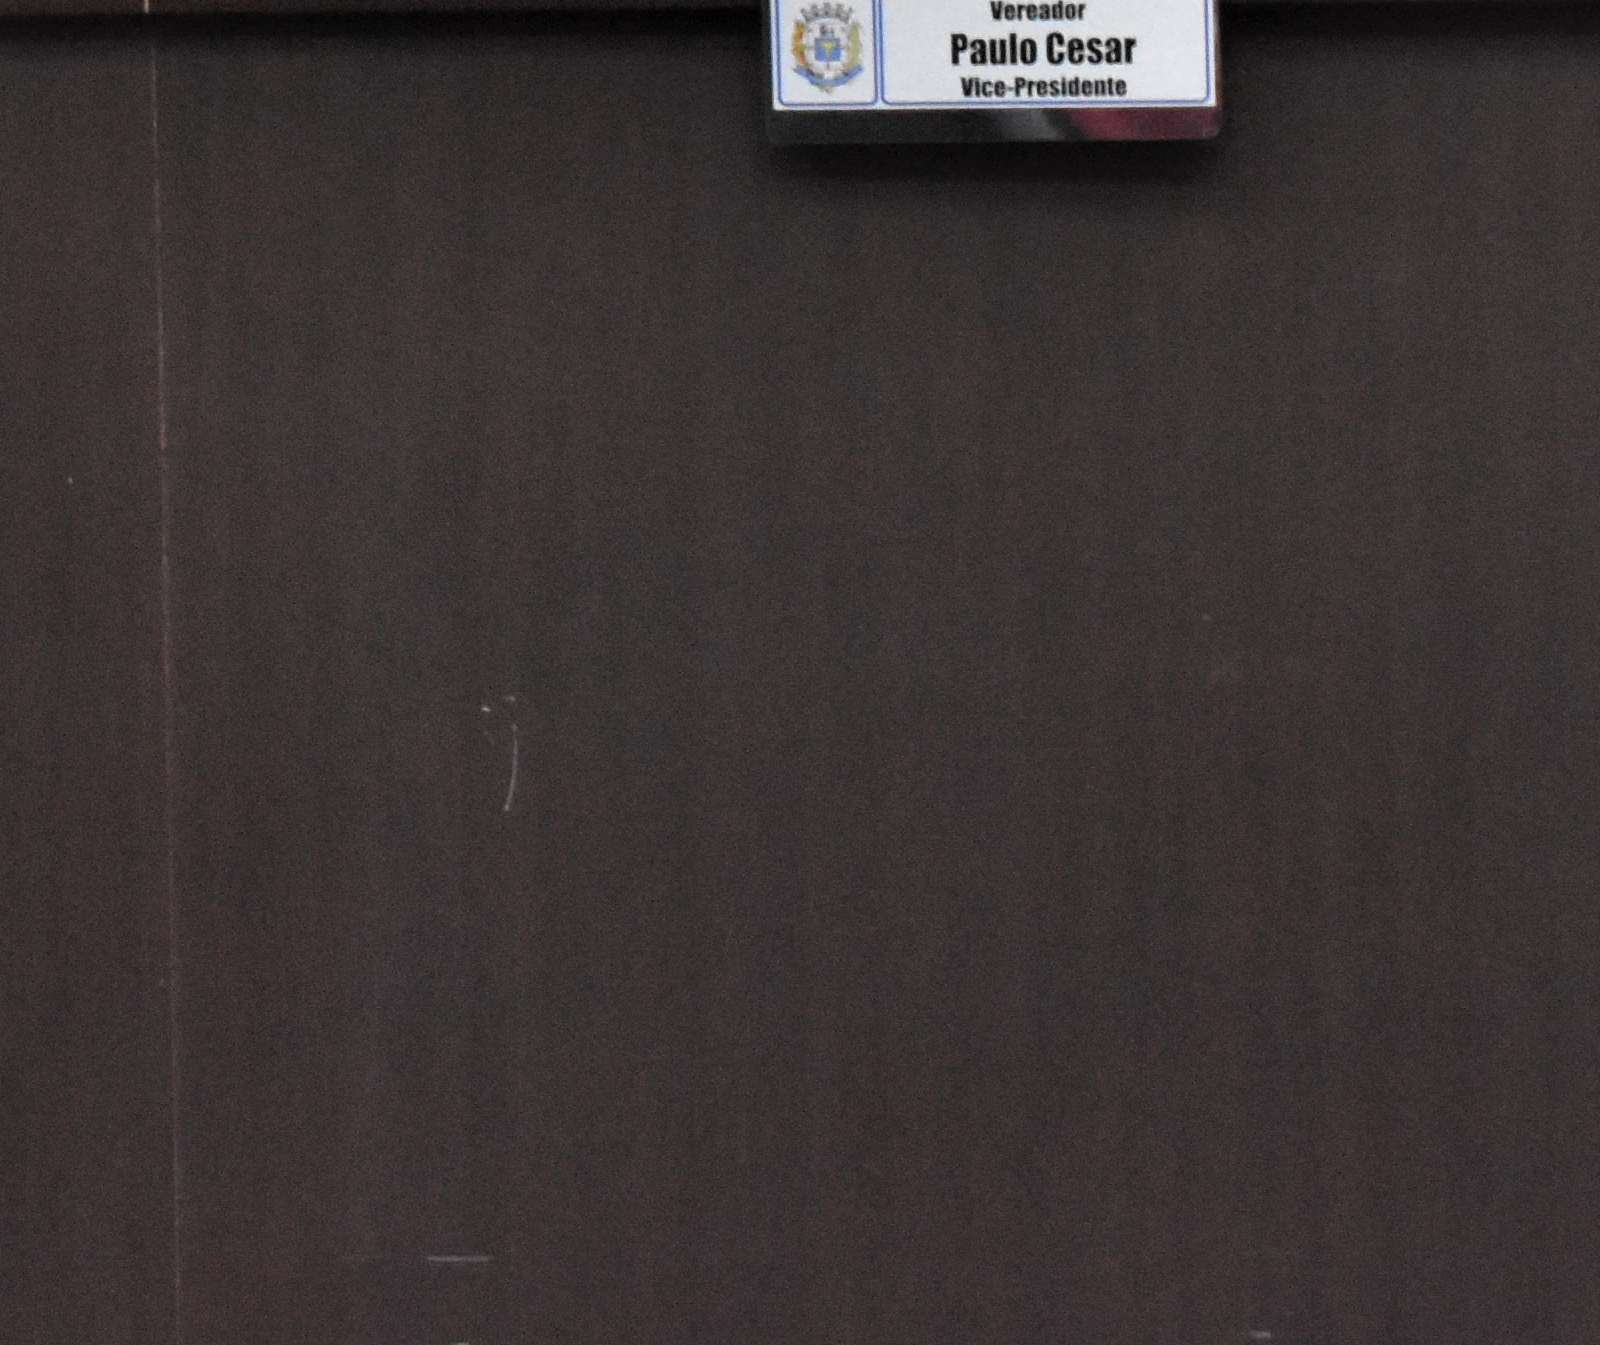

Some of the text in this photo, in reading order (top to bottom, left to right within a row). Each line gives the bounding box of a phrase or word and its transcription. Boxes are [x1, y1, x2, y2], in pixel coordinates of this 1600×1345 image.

[990, 0, 1086, 21] Vereador
[950, 32, 1137, 66] Paulo Cesar
[961, 76, 1127, 98] Vice-Presidente
